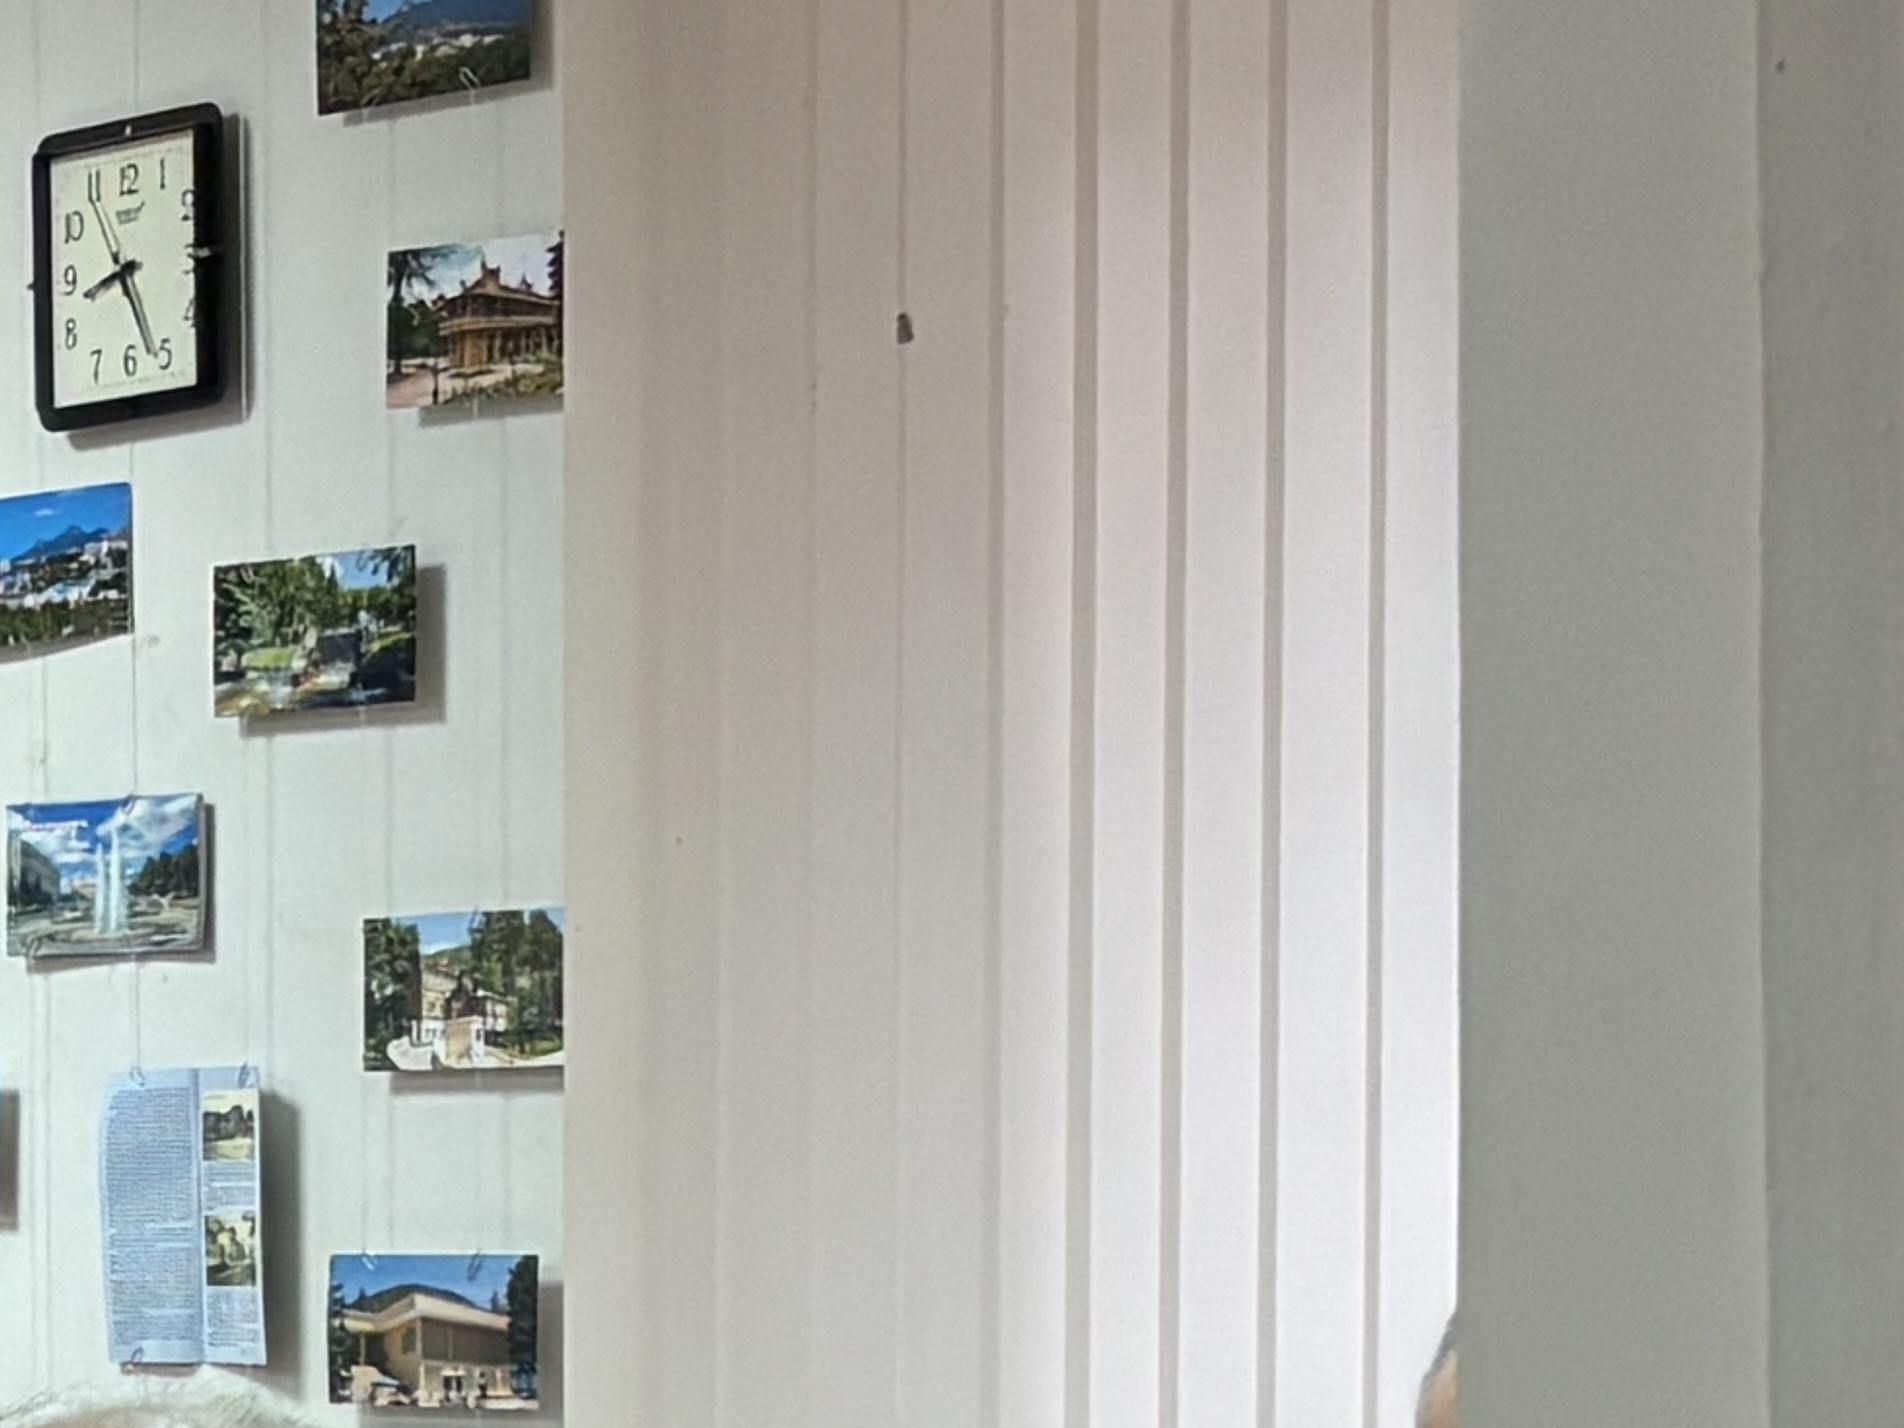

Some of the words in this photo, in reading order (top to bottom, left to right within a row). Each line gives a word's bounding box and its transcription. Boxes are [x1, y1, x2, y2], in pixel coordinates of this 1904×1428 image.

[88, 169, 101, 202] 11
[119, 163, 139, 197] 12
[158, 158, 166, 191] 1
[64, 211, 84, 243] 10
[64, 265, 77, 296] 9
[64, 318, 77, 349] 8
[90, 349, 102, 385] 7
[124, 345, 137, 377] 6
[158, 338, 172, 371] 5
